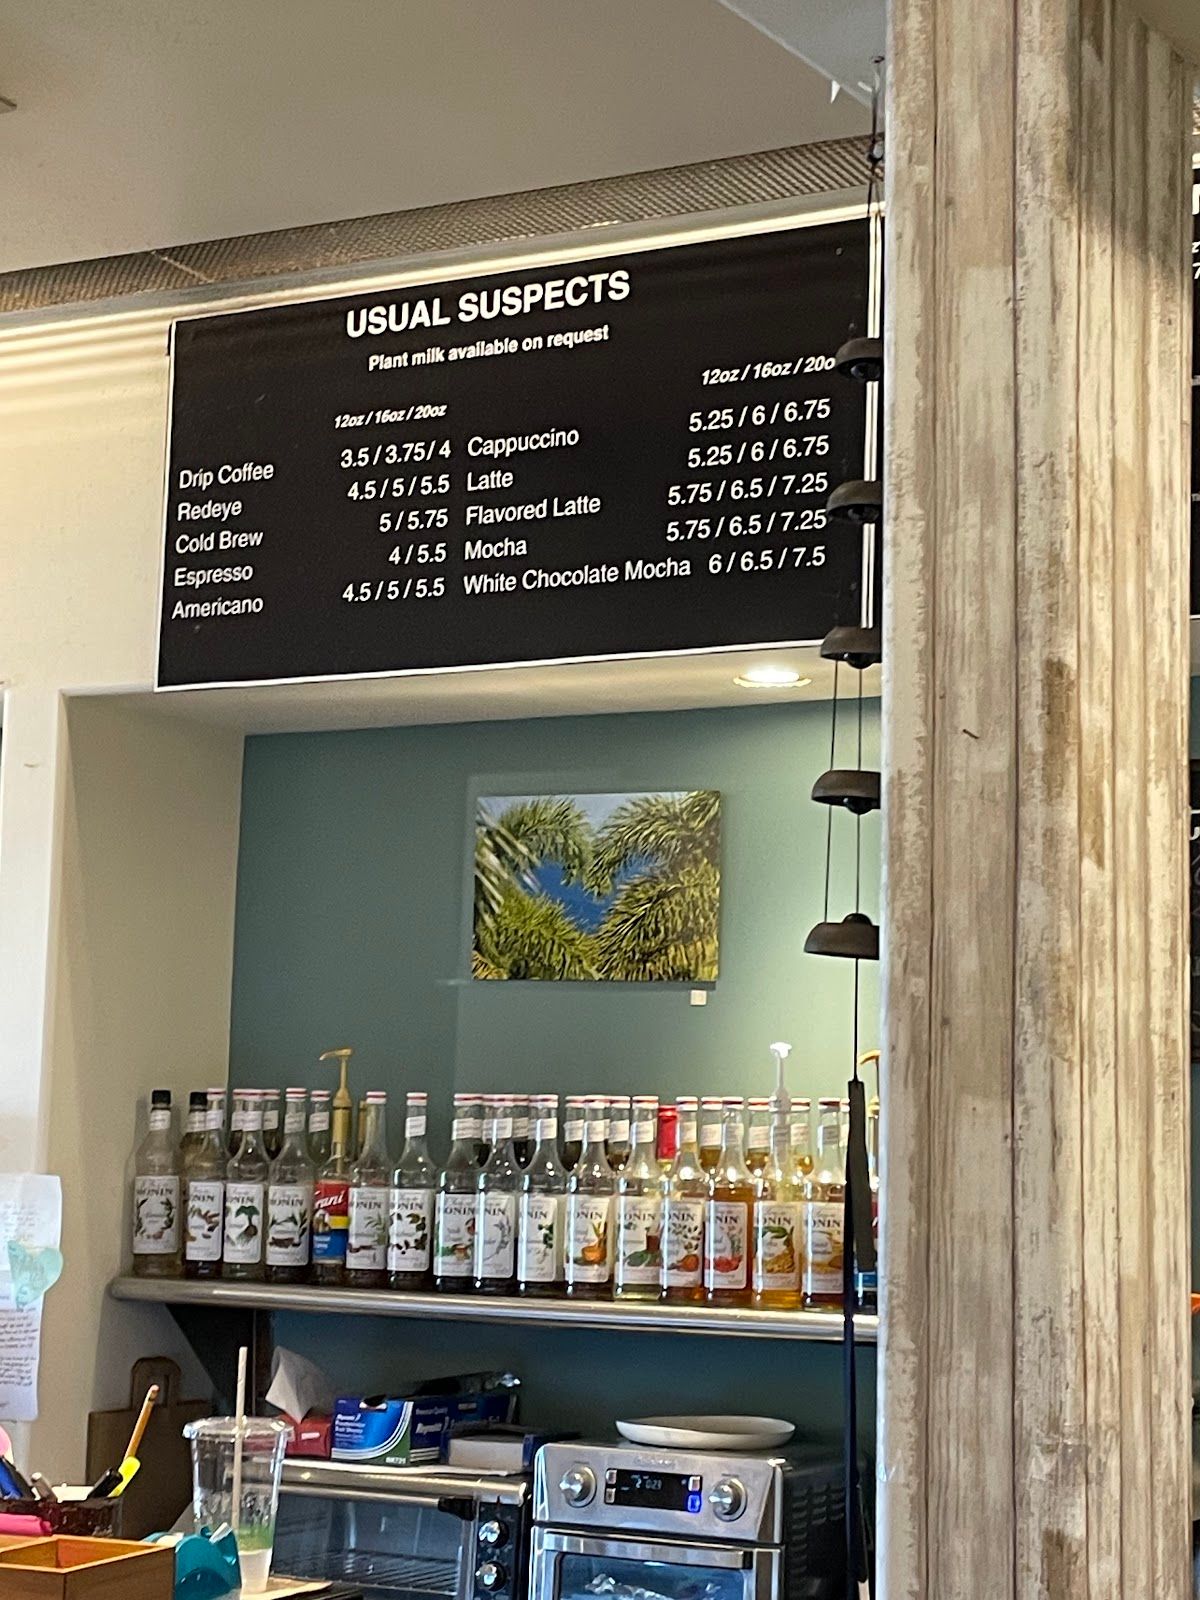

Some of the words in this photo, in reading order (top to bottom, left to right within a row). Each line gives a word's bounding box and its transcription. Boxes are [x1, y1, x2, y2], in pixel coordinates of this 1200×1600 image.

[346, 298, 451, 338] USUAL
[457, 270, 631, 323] SUSPECTS
[368, 351, 409, 372] Plant
[411, 346, 445, 366] milk
[447, 338, 519, 361] available
[521, 337, 543, 351] on
[547, 324, 609, 349] request
[702, 364, 740, 386] 12oz
[740, 364, 752, 381] /
[753, 358, 794, 379] 16oz
[792, 357, 804, 374] /
[803, 355, 837, 373] 20o
[334, 410, 366, 429] 12oz
[365, 410, 374, 426] /
[375, 406, 406, 424] 16oz
[405, 405, 415, 421] /
[413, 404, 448, 421] 20oz
[688, 408, 734, 433] 5.25
[737, 405, 749, 428] /
[751, 405, 766, 426] 6
[769, 402, 780, 425] /
[783, 399, 831, 423] 6.75
[340, 446, 370, 469] 3.5
[372, 445, 383, 466] /
[384, 440, 427, 465] 3.75
[426, 439, 437, 461] /
[438, 439, 452, 459] 4
[467, 430, 580, 458] Cappuccino
[687, 444, 733, 468] 5.25
[736, 442, 747, 464] /
[750, 442, 765, 462] 6
[768, 439, 779, 461] /
[783, 435, 830, 459] 6.75
[179, 469, 214, 493] Drip
[217, 462, 275, 485] Coffee
[347, 478, 377, 501] 4.5
[379, 478, 390, 499] /
[391, 477, 405, 498] 5
[407, 475, 418, 497] /
[420, 473, 450, 496] 5.5
[467, 470, 514, 492] Latte
[667, 482, 713, 506] 5.75
[716, 480, 727, 502] /
[730, 477, 764, 500] 6.5
[766, 475, 778, 497] /
[781, 471, 828, 496] 7.25
[177, 499, 243, 522] Redeye
[379, 512, 392, 533] 5
[394, 510, 405, 532] /
[407, 507, 449, 530] 5.75
[465, 500, 548, 526] Flavored
[552, 495, 601, 517] Latte
[665, 518, 711, 542] 5.75
[714, 516, 726, 538] /
[729, 514, 762, 536] 6.5
[765, 511, 777, 534] /
[780, 508, 827, 532] 7.25
[175, 533, 215, 555] Cold
[218, 530, 264, 550] Brew
[388, 545, 401, 565] 4
[404, 543, 414, 565] /
[416, 541, 447, 564] 5.5
[464, 537, 528, 561] Mocha
[708, 553, 722, 574] 6
[725, 551, 737, 573] /
[740, 549, 774, 572] 6.5
[777, 547, 788, 569] /
[792, 545, 826, 568] 7.5
[174, 565, 254, 589] Espresso
[342, 580, 372, 602] 4.5
[374, 580, 384, 601] /
[387, 580, 400, 601] 5
[402, 578, 413, 600] /
[415, 577, 445, 599] 5.5
[463, 572, 517, 595] White
[521, 564, 620, 591] Chocolate
[624, 556, 692, 582] Mocha
[172, 597, 264, 620] Americano
